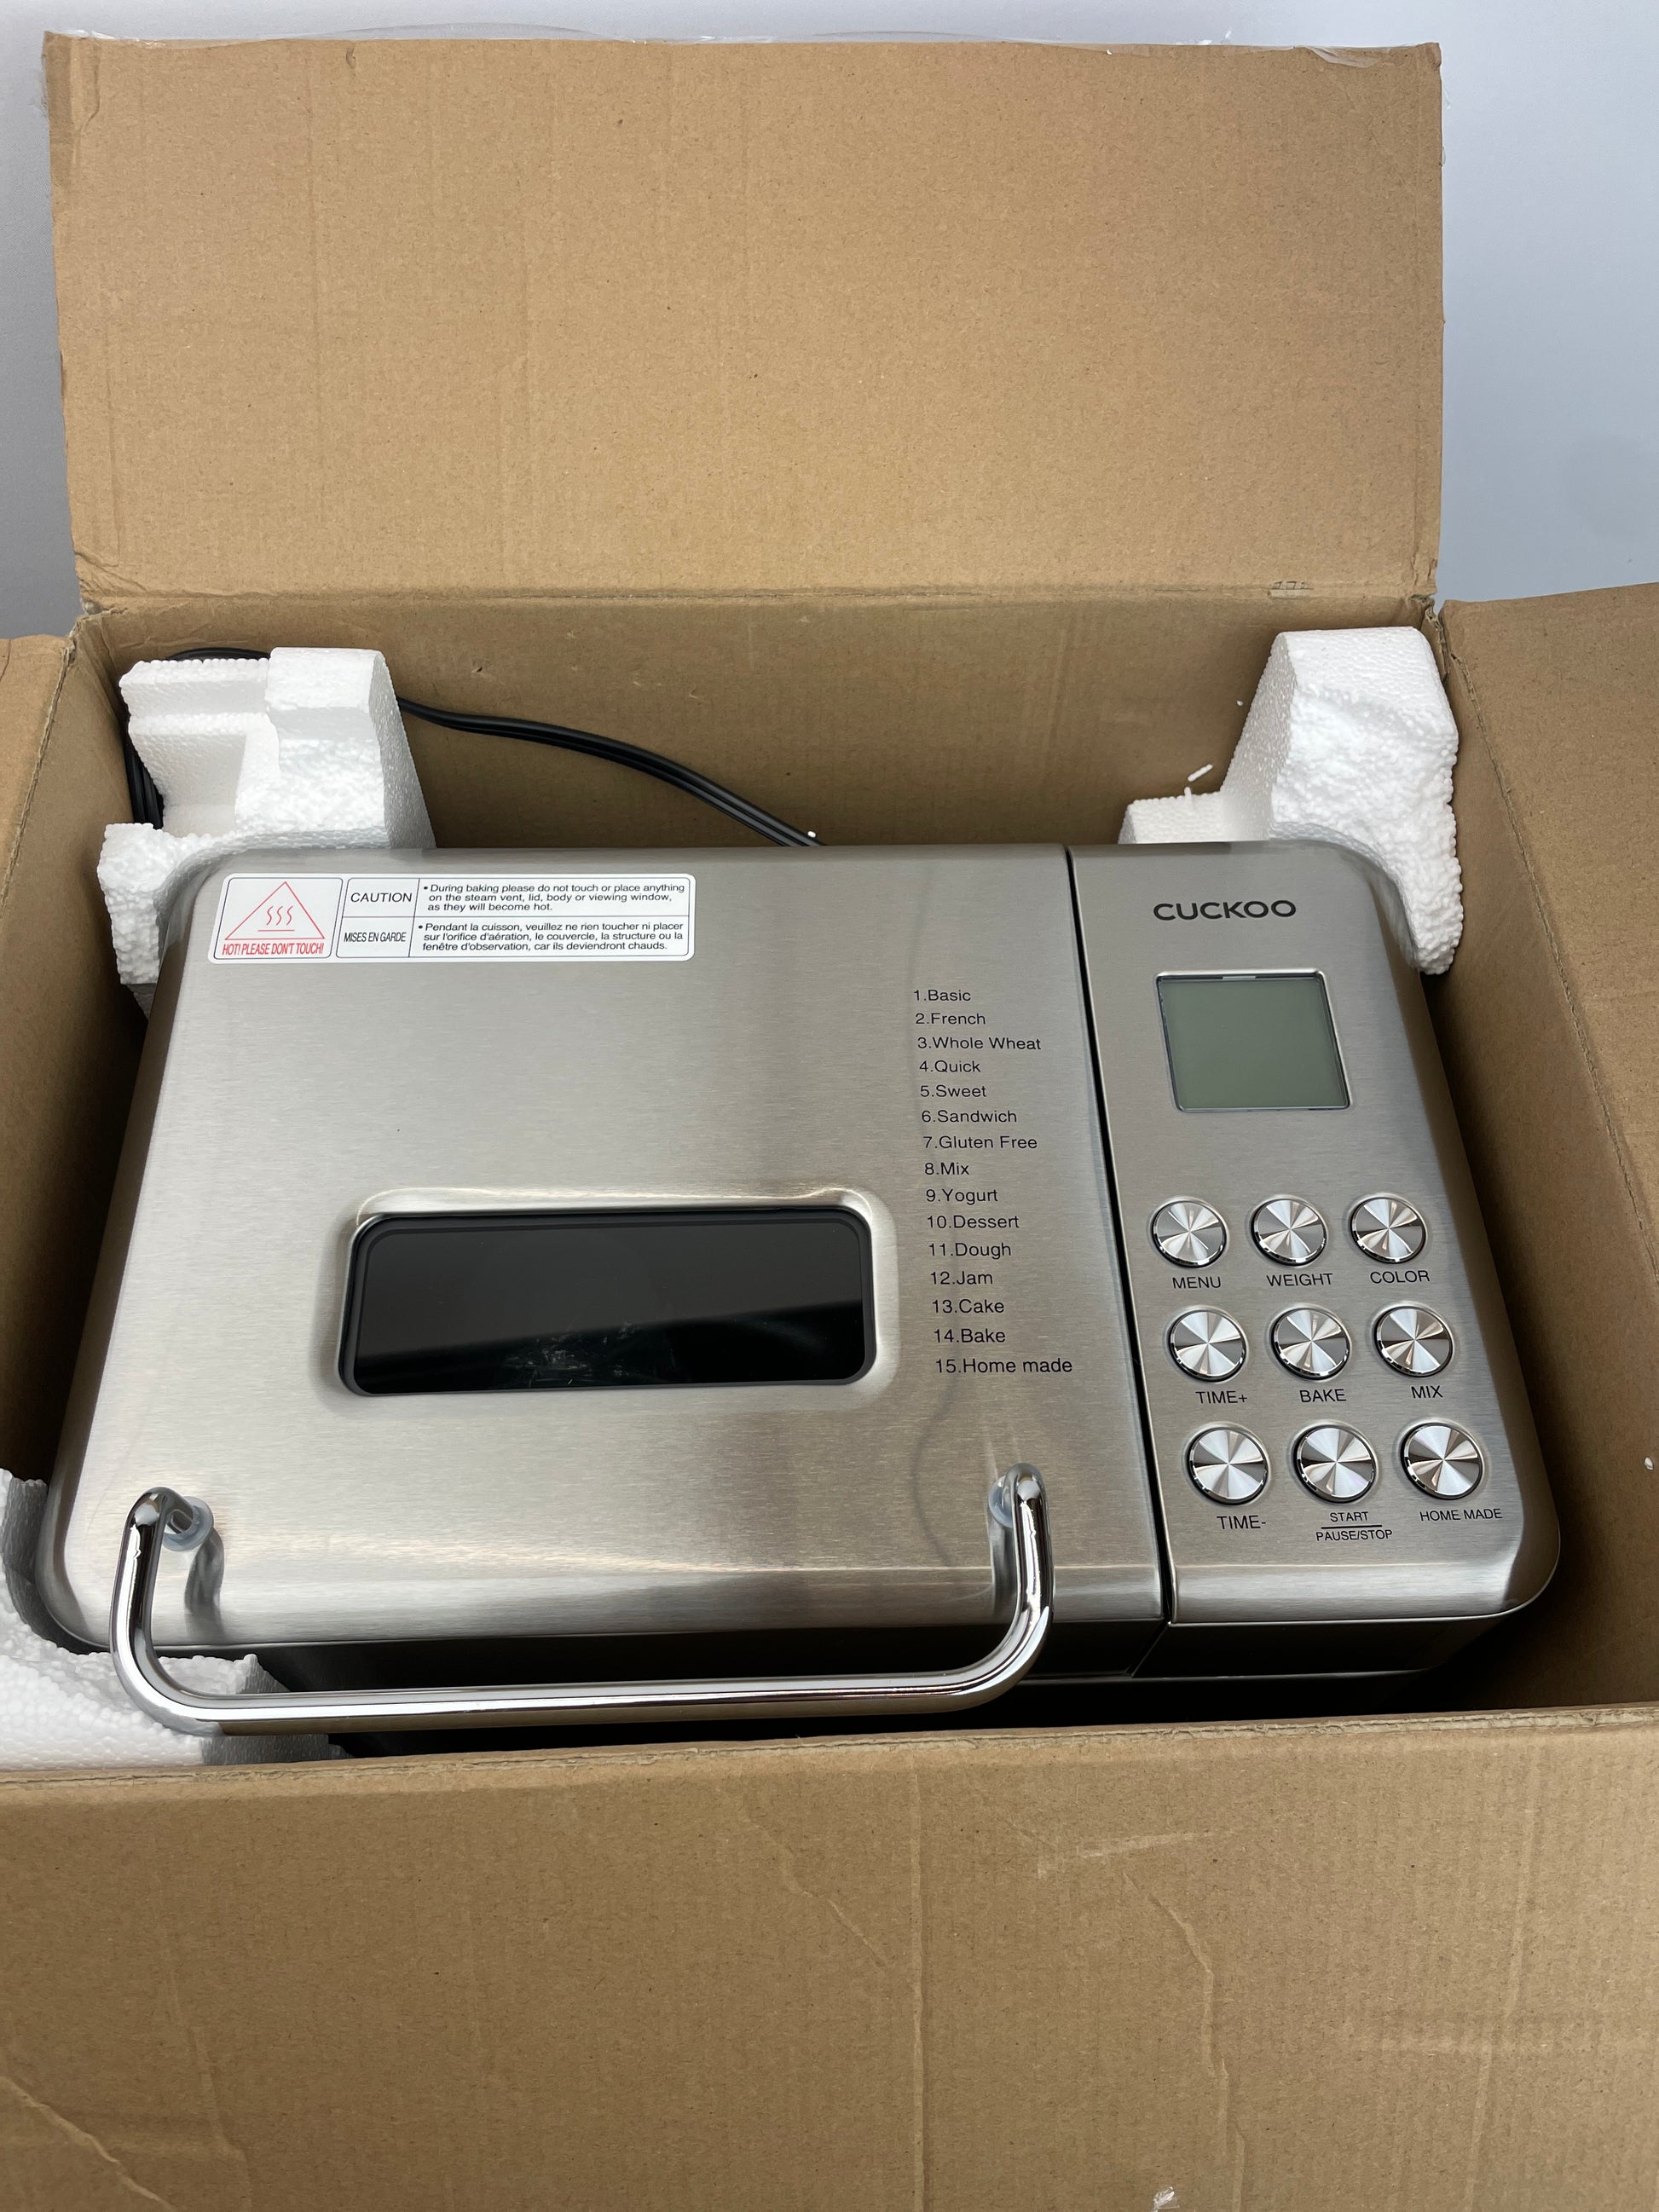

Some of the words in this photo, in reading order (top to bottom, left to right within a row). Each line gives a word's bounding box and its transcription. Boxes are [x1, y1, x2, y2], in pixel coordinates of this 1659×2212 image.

[431, 885, 463, 893] During
[466, 885, 499, 893] baking
[502, 885, 535, 893] please
[614, 884, 640, 892] place
[643, 884, 685, 892] anything
[350, 892, 412, 902] CAUTION
[546, 893, 572, 903] body
[589, 893, 627, 902] viewing
[443, 904, 465, 912] they
[1153, 900, 1297, 921] CUCKOO
[482, 923, 523, 932] cuisson,
[653, 922, 683, 931] placer
[344, 933, 367, 942] MISES
[368, 933, 380, 942] EN
[381, 933, 407, 942] GARDE
[223, 944, 240, 955] HOT!
[241, 944, 271, 954] PLEASE
[271, 943, 295, 954] DON'T
[296, 943, 324, 954] TOUCH!
[914, 989, 971, 1002] 1.Basic
[916, 1012, 986, 1025] 2.French
[917, 1037, 983, 1050] 3.Whole
[989, 1037, 1041, 1050] Wheat
[920, 1060, 980, 1073] 4.Quick
[920, 1084, 986, 1098] 5.Sweet
[922, 1110, 1017, 1123] 6.Sandwich
[923, 1135, 993, 1150] 7.Gluten
[999, 1135, 1038, 1150] Free
[925, 1162, 969, 1175] 8.Mix
[926, 1188, 998, 1205] 9.Yogurt
[928, 1216, 1020, 1229] 10.Dessert
[929, 1243, 1011, 1260] 11.Dough
[930, 1271, 993, 1285] 12.Jam
[1172, 1277, 1221, 1290] MENU
[1267, 1273, 1333, 1287] WEIGHT
[1370, 1271, 1430, 1284] COLOR
[932, 1299, 1004, 1314] 13.Cake
[934, 1328, 1006, 1343] 14.Bake
[935, 1358, 1016, 1374] 15.Home
[1022, 1358, 1072, 1374] made
[1196, 1391, 1247, 1405] TIME+
[1300, 1389, 1346, 1403] BAKE
[1412, 1385, 1443, 1399] MIX
[1330, 1512, 1368, 1522] START
[1420, 1510, 1460, 1522] HOME
[1464, 1508, 1503, 1520] MADE
[1217, 1516, 1266, 1530] TIME-
[1316, 1530, 1393, 1542] PAUSE/STOP
